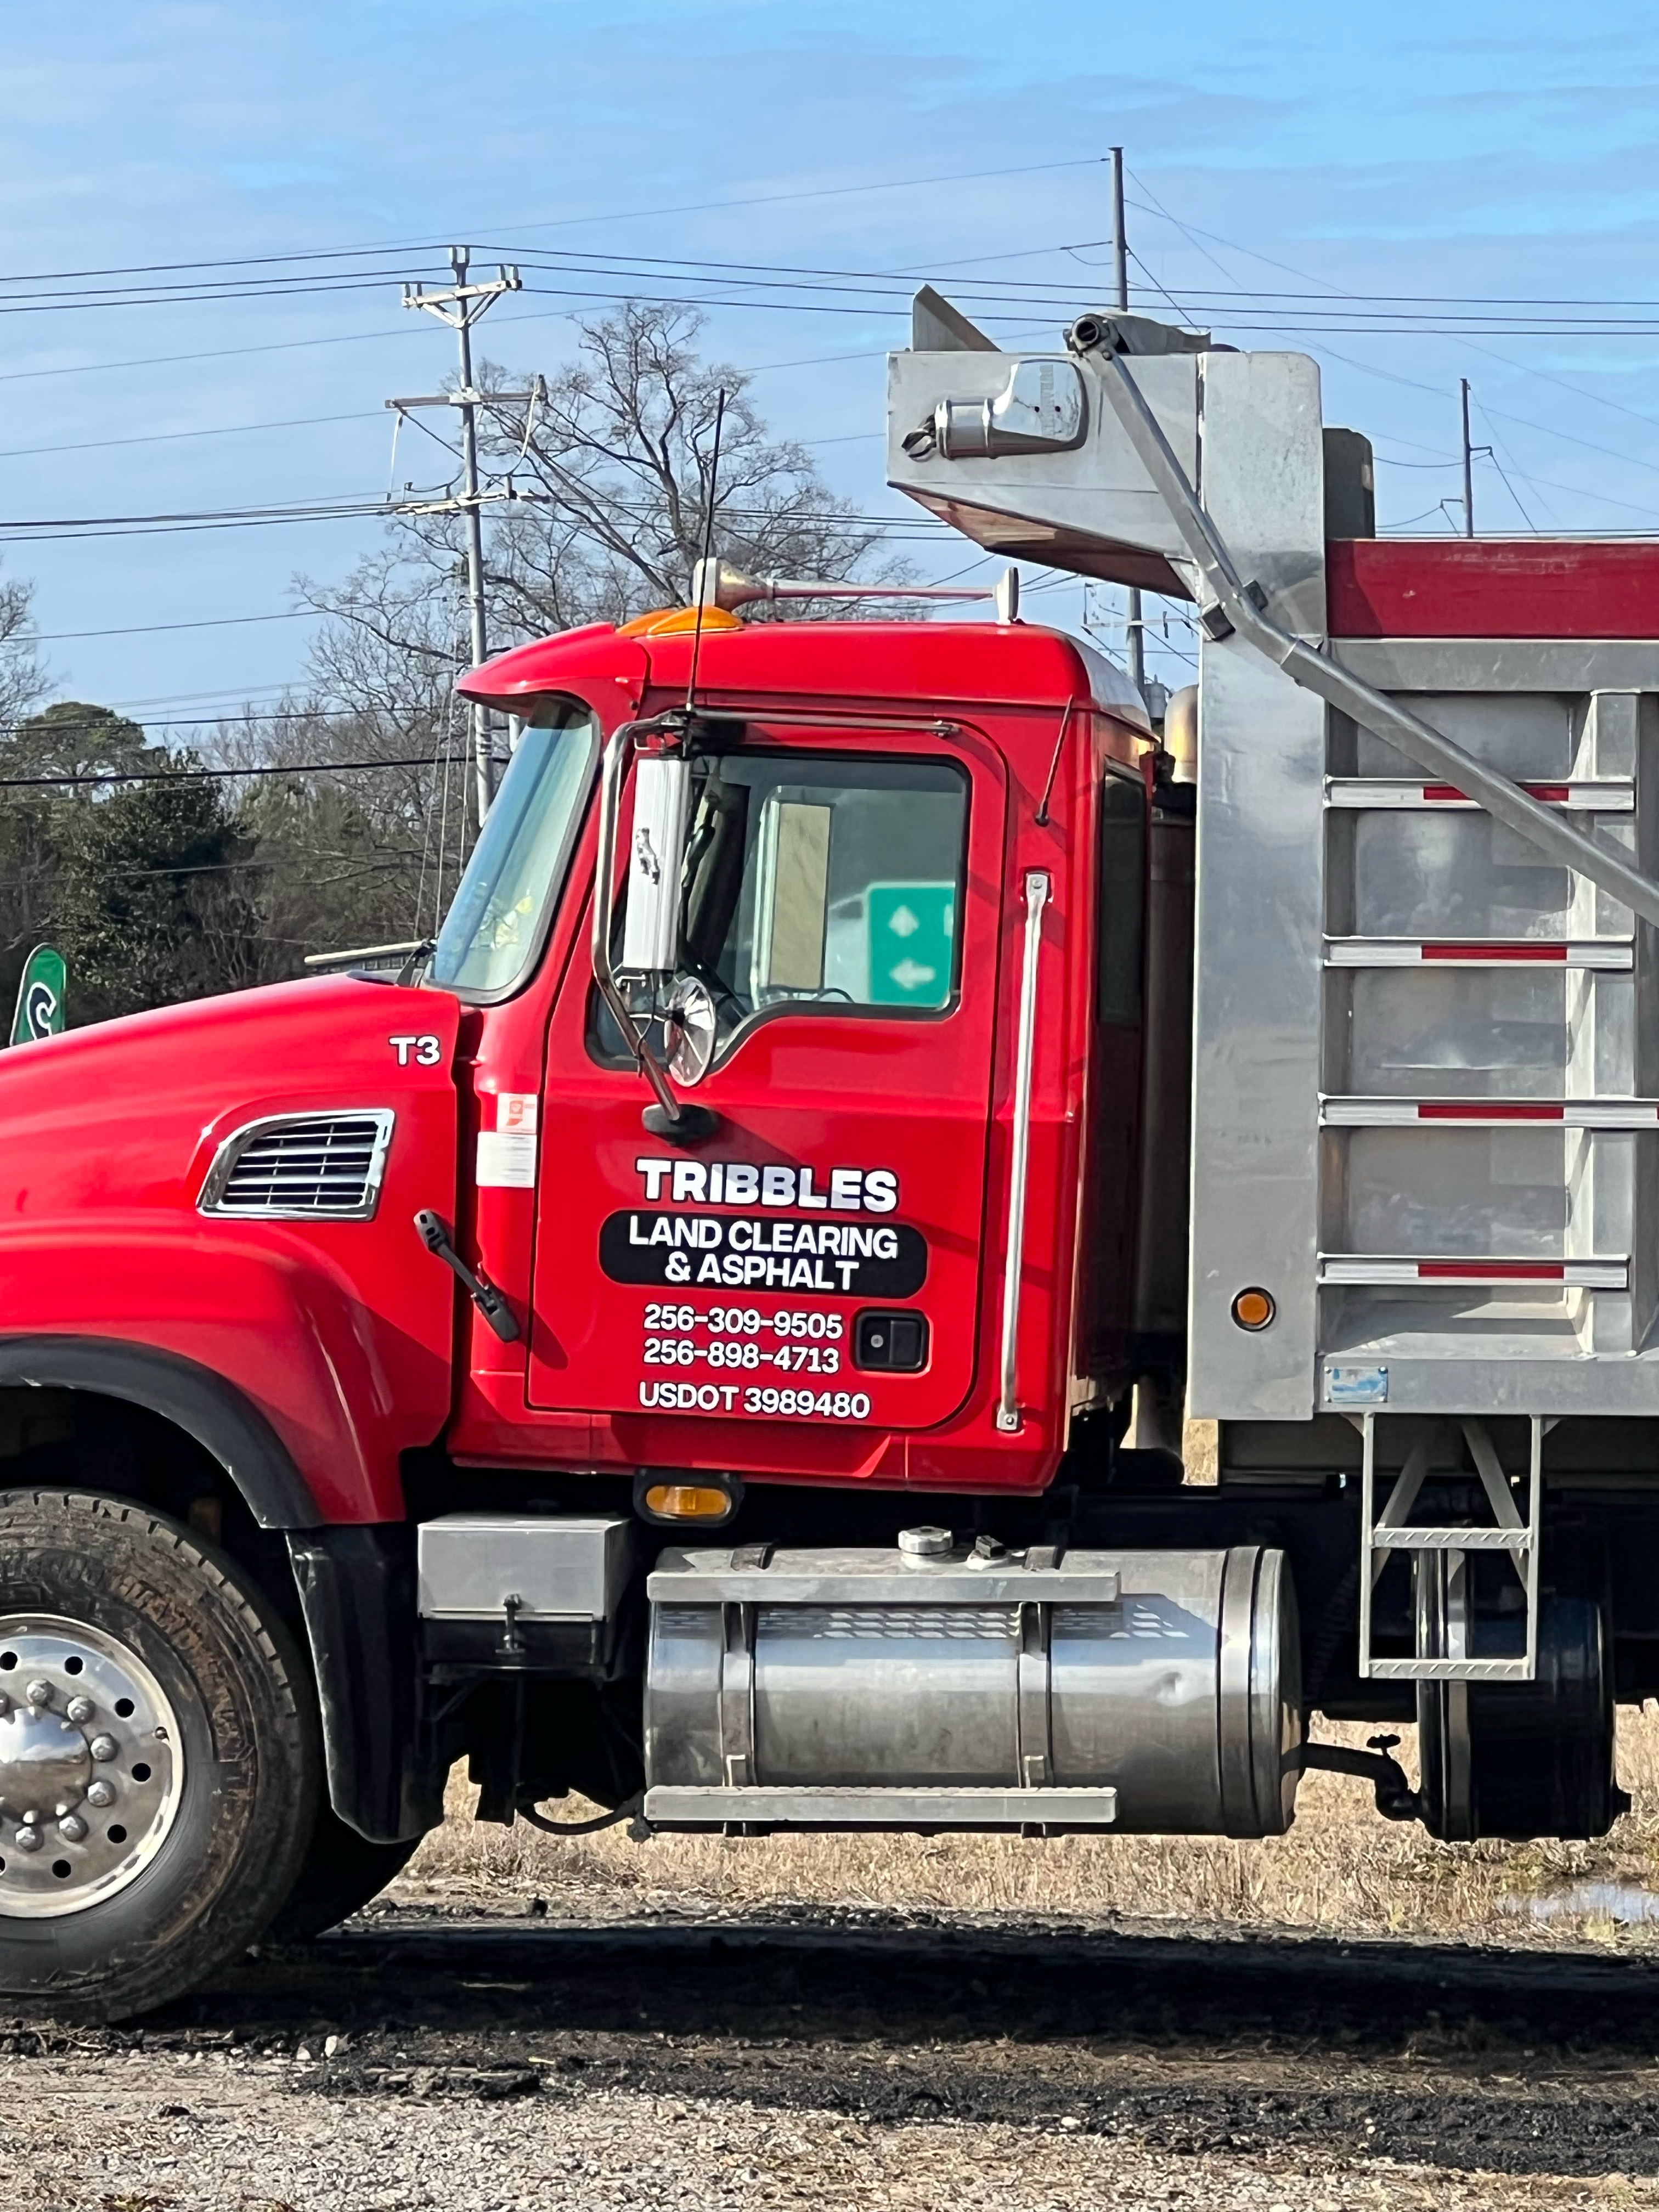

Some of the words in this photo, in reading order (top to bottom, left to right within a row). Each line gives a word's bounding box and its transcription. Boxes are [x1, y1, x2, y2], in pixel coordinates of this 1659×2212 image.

[388, 1035, 441, 1065] T3
[636, 1158, 898, 1213] TRIBBLES
[629, 1215, 723, 1249] LAND
[727, 1220, 899, 1260] CLEARING
[664, 1250, 691, 1282] &
[696, 1252, 860, 1291] ASPHALT
[643, 1303, 843, 1340] 256-309-9505
[643, 1337, 839, 1374] 256-898-4713
[639, 1381, 740, 1411] USDOT
[743, 1387, 871, 1419] 3989480
